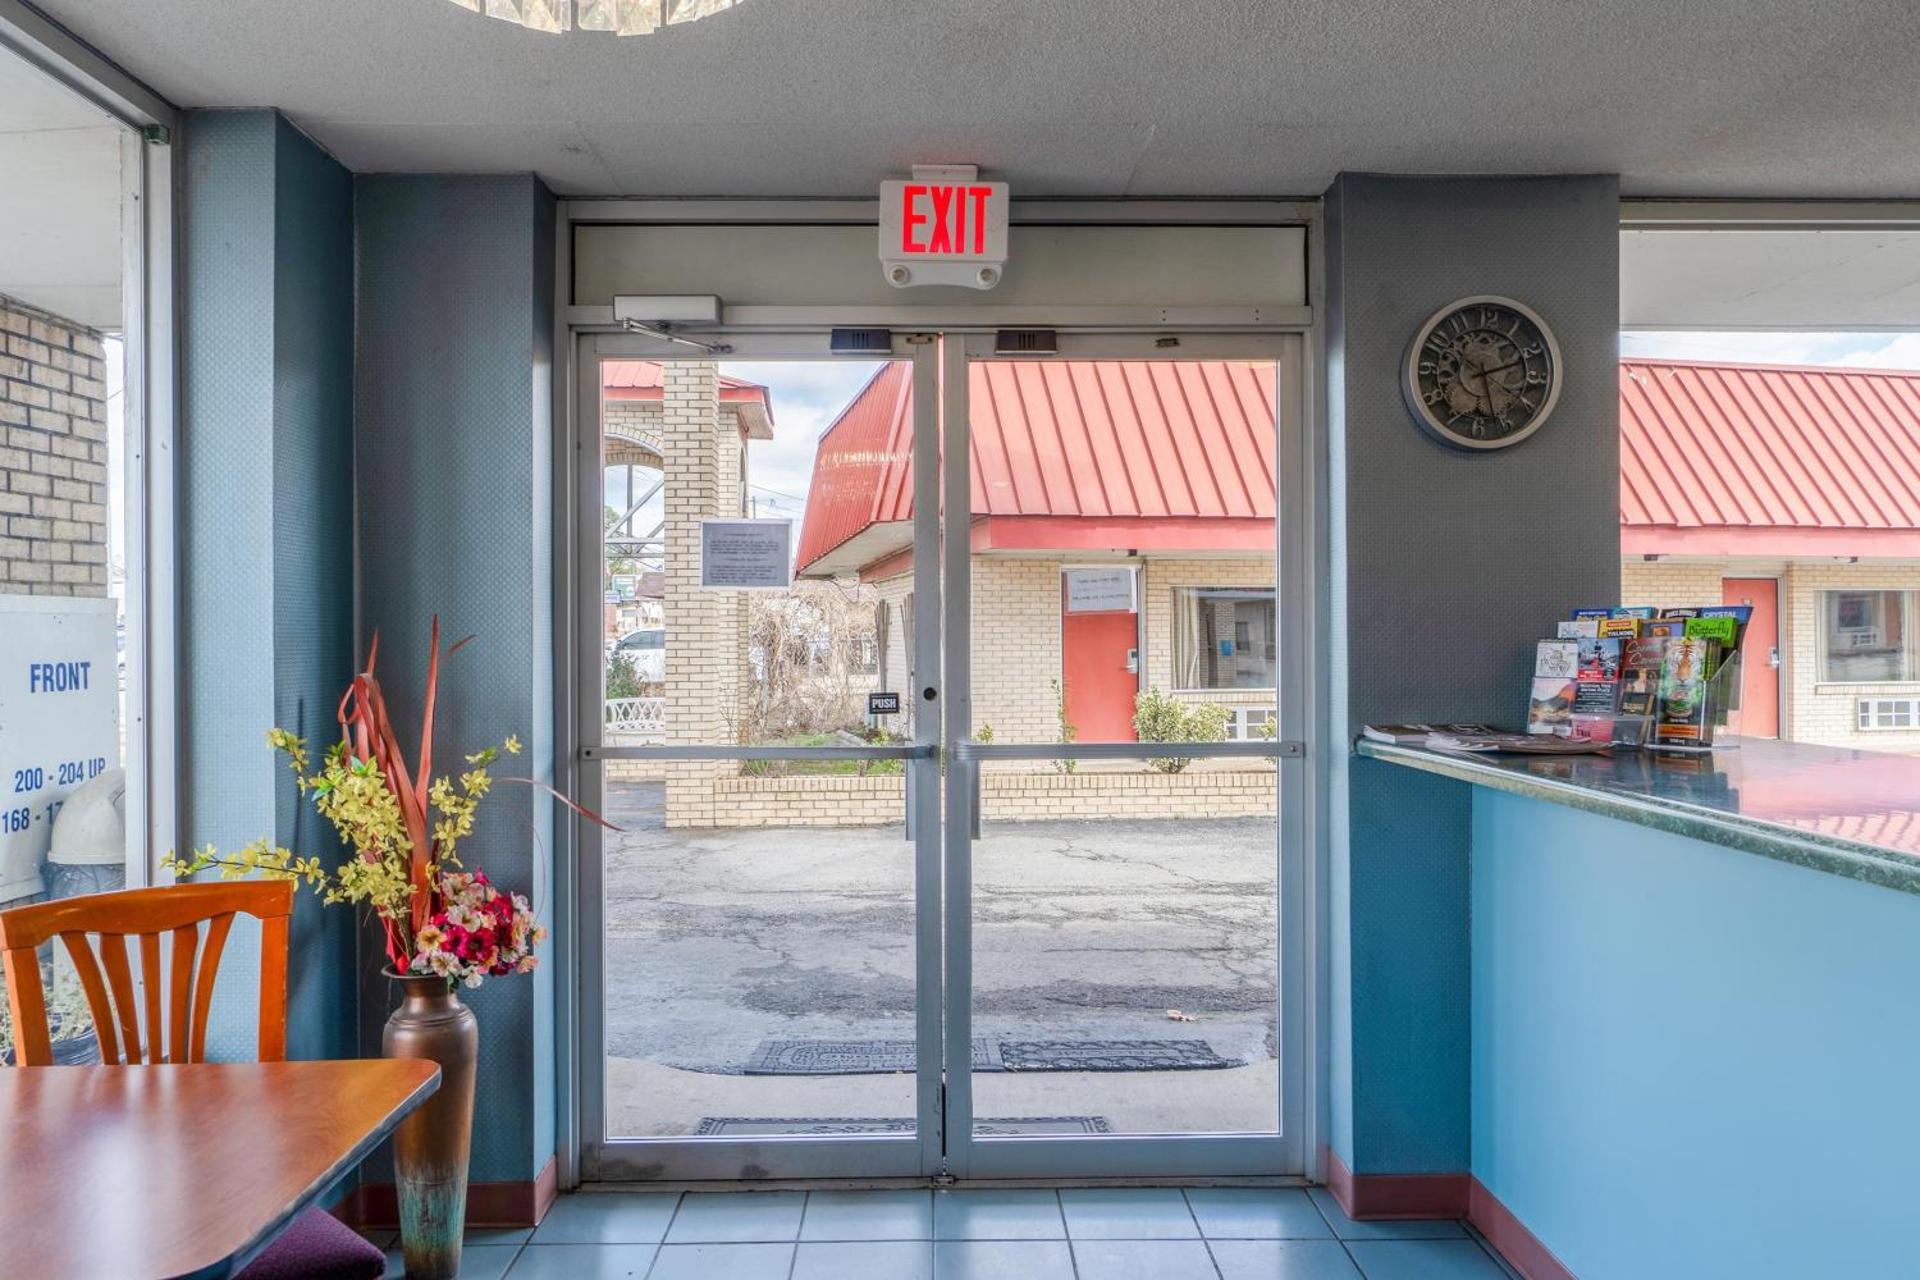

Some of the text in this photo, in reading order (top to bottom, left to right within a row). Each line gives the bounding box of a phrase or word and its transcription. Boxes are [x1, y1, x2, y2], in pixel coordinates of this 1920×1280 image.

[903, 186, 992, 254] EXIT
[1480, 307, 1498, 328] 12
[1689, 620, 1729, 637] Butterfly
[30, 661, 91, 693] FRONT
[872, 698, 897, 709] PUSH
[15, 767, 43, 793] 200
[58, 761, 84, 785] 204
[88, 757, 106, 779] UP
[2, 806, 30, 834] 168
[46, 800, 64, 826] 17
